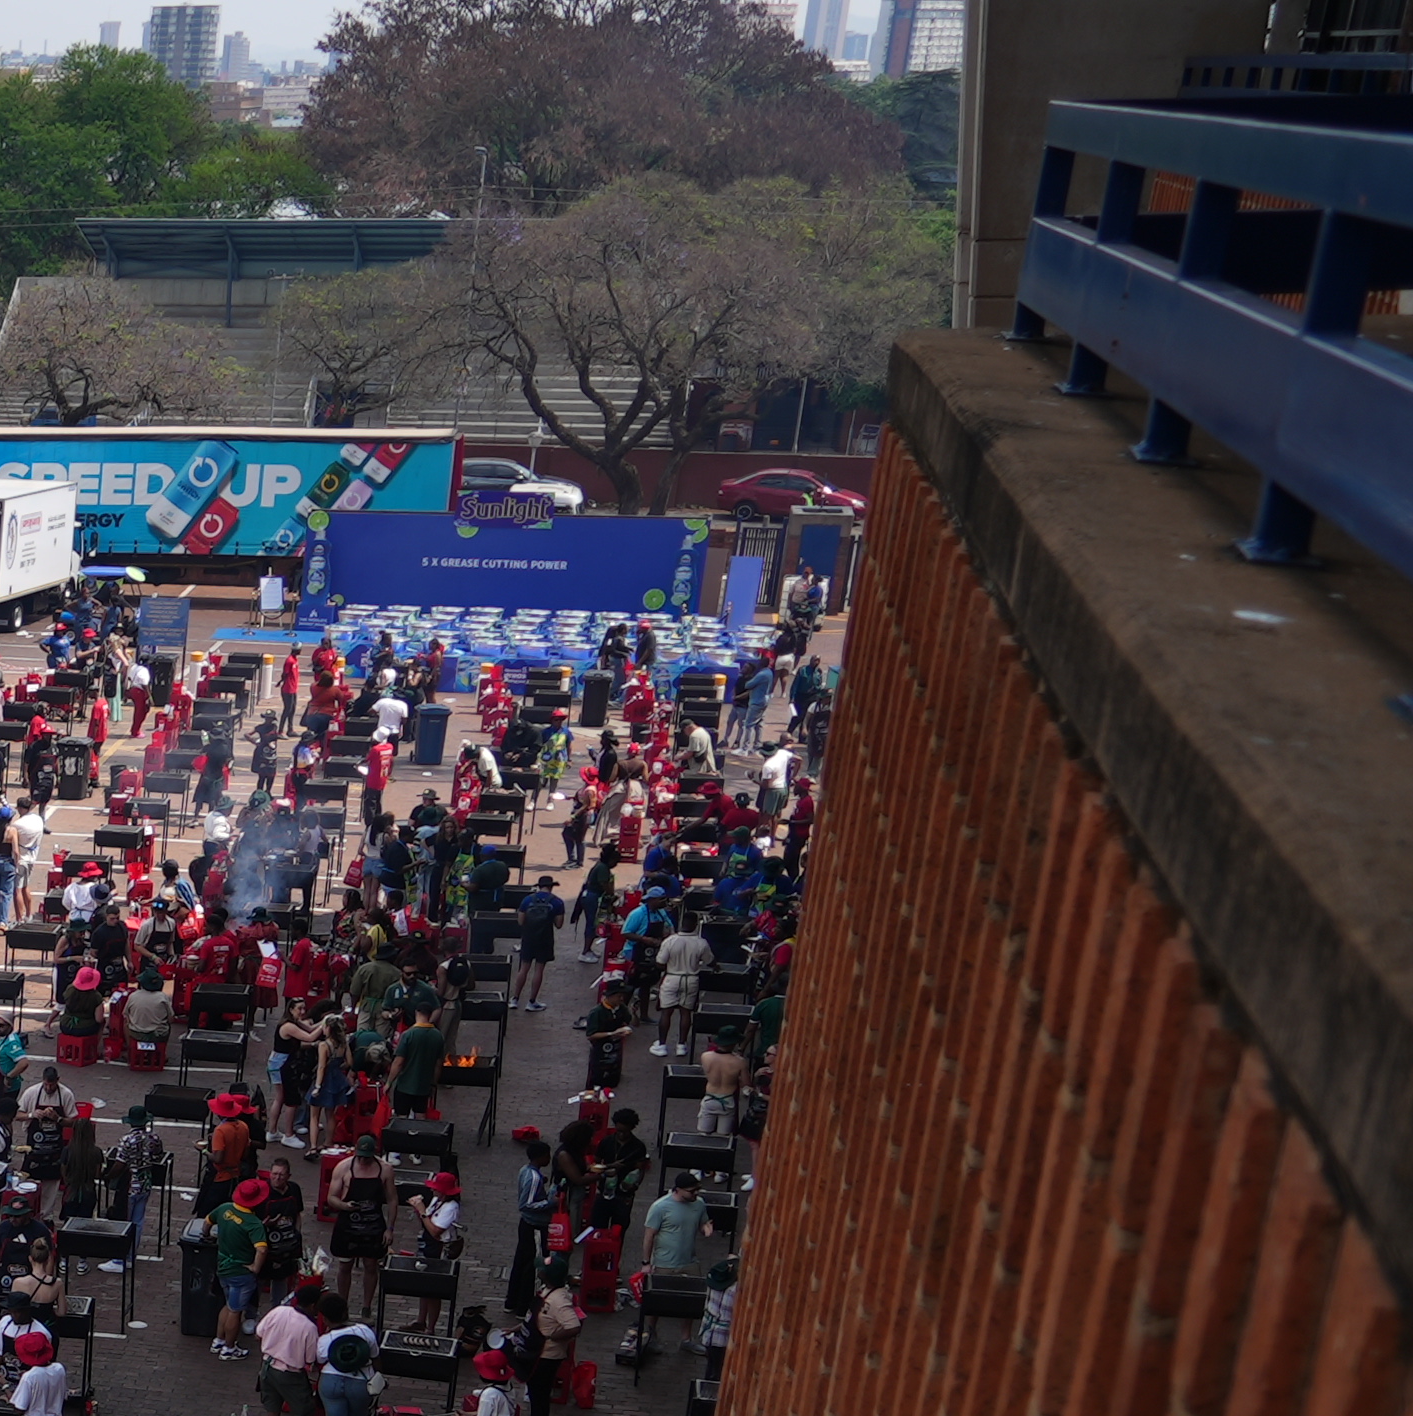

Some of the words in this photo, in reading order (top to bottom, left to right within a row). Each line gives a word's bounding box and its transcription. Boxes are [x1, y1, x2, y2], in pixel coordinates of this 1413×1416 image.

[220, 463, 302, 508] UP
[76, 513, 125, 528] ERGY
[460, 496, 552, 524] Sunlight
[422, 557, 429, 567] 5
[431, 557, 438, 567] X
[440, 557, 480, 568] GREASE
[481, 559, 528, 569] CUTTING
[530, 560, 568, 571] POWER
